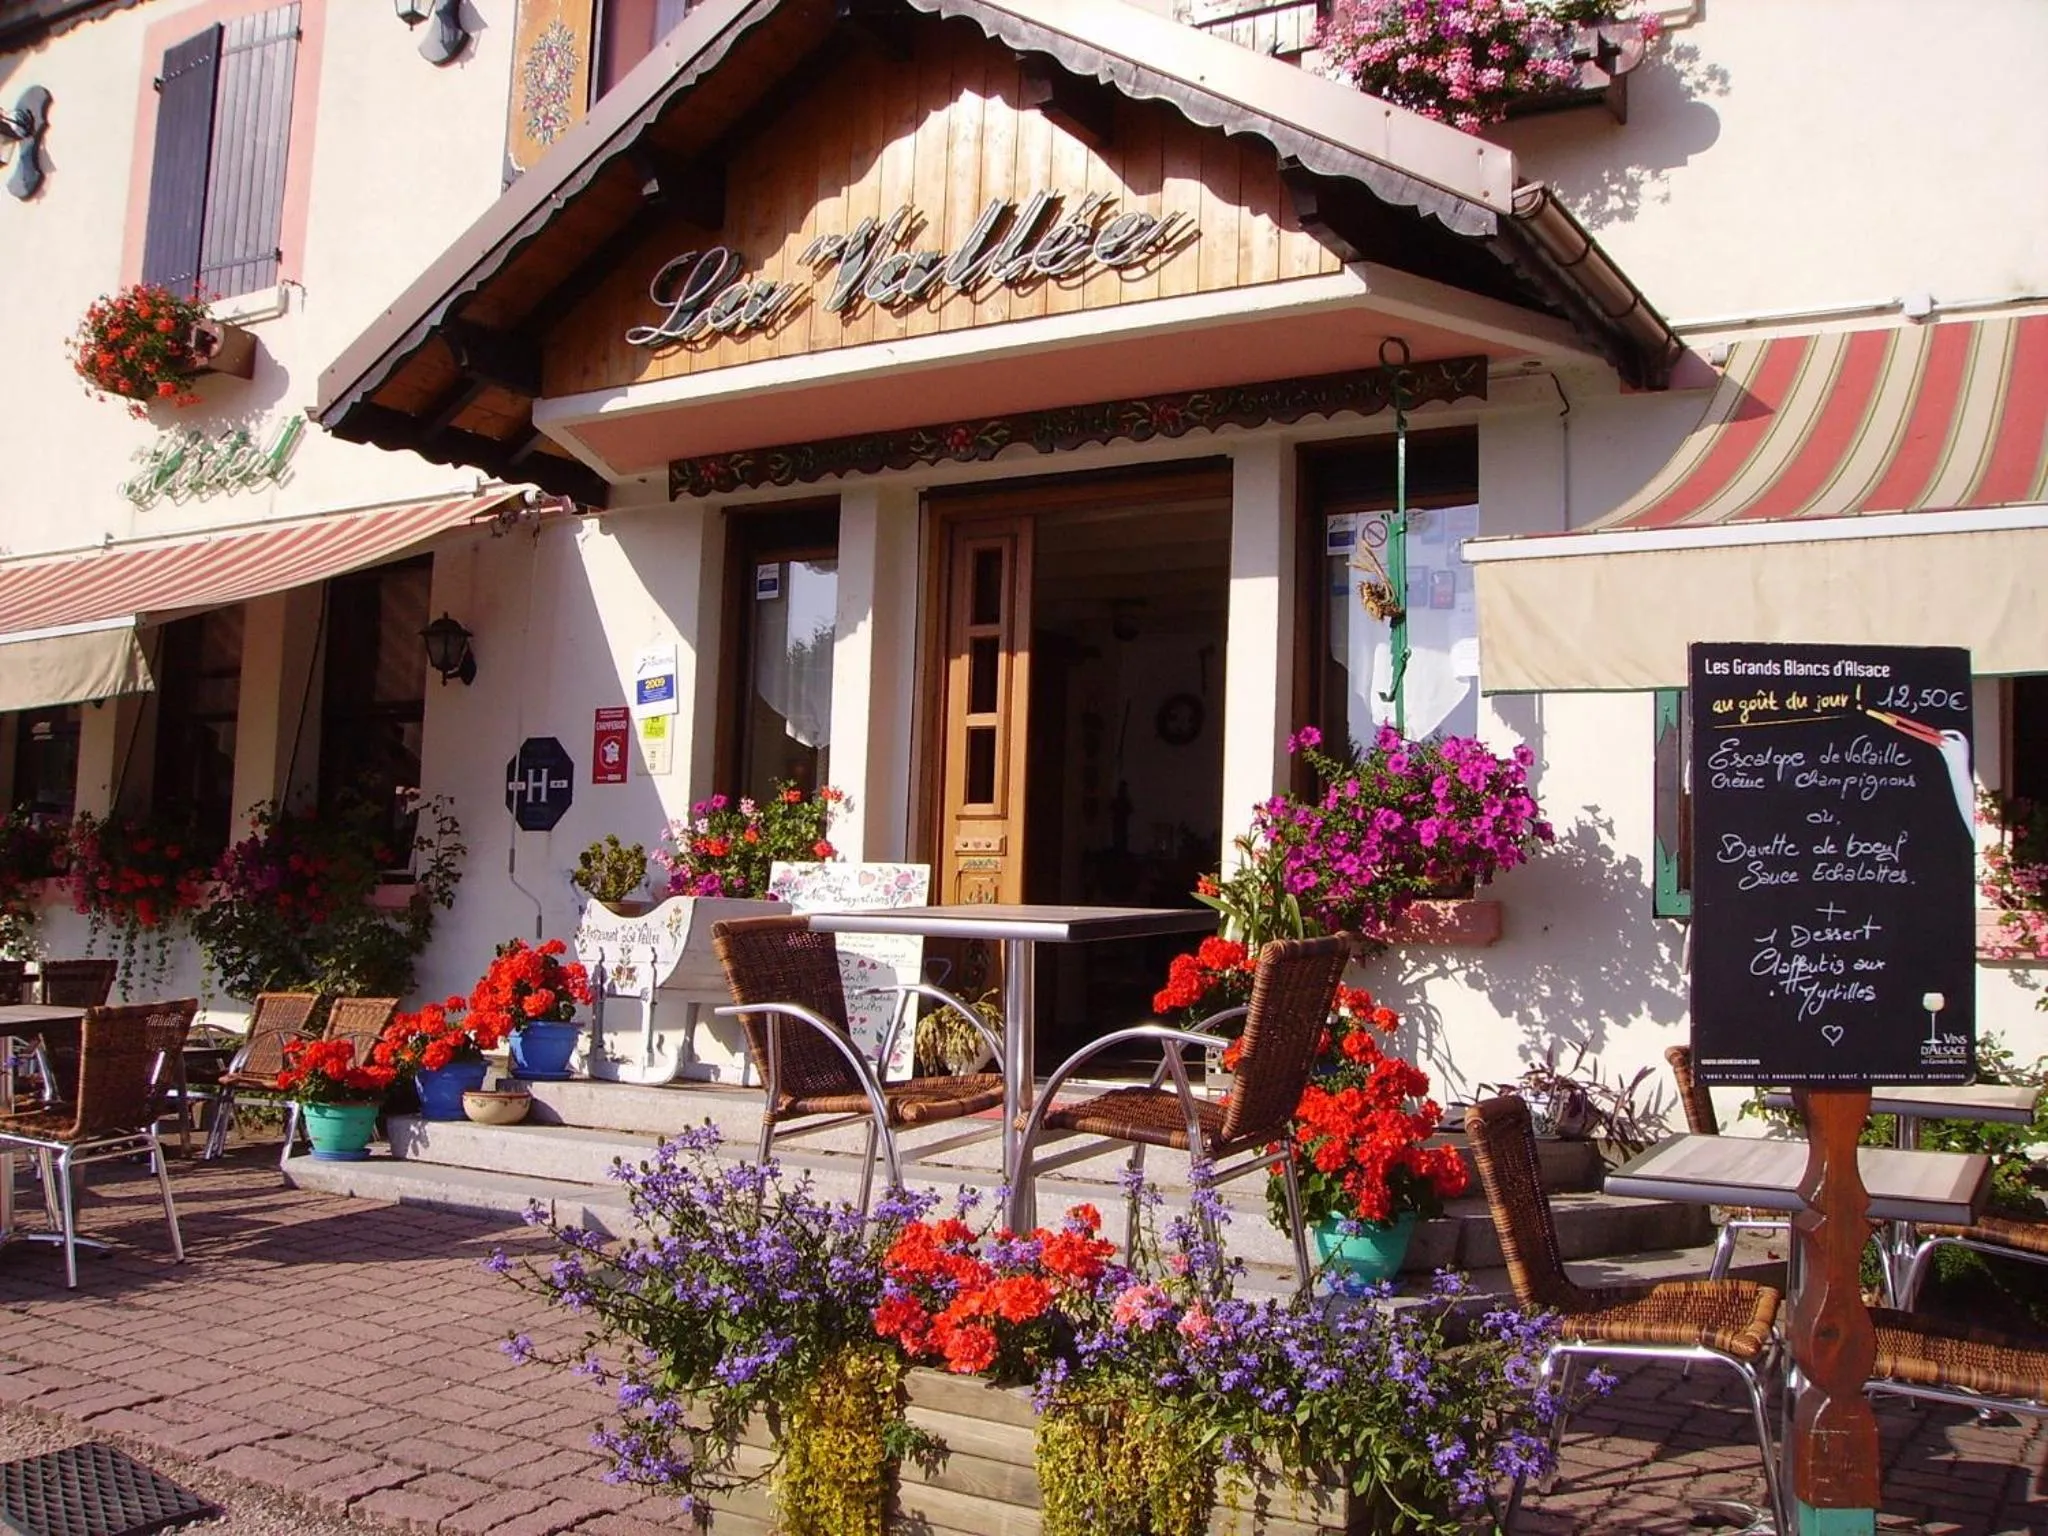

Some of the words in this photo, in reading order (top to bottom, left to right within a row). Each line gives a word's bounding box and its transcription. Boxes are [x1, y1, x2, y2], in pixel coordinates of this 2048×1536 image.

[625, 246, 799, 350] La
[801, 188, 1194, 313] Vallée
[1704, 659, 1730, 676] Les
[1732, 660, 1781, 677] Grands
[1783, 660, 1831, 678] Blancs
[1833, 660, 1891, 678] d'Alsace
[1712, 696, 1734, 714] au
[1738, 690, 1780, 724] goût
[1785, 692, 1808, 709] du
[1814, 692, 1849, 713] jour
[1876, 685, 1969, 714] 12,50€
[1819, 742, 1842, 765] de
[526, 768, 548, 803] H
[1716, 832, 1801, 864] Bavette
[1812, 835, 1839, 855] de
[1738, 860, 1800, 891] Sauce
[1790, 914, 1883, 949] Dessert
[1852, 958, 1888, 971] aux
